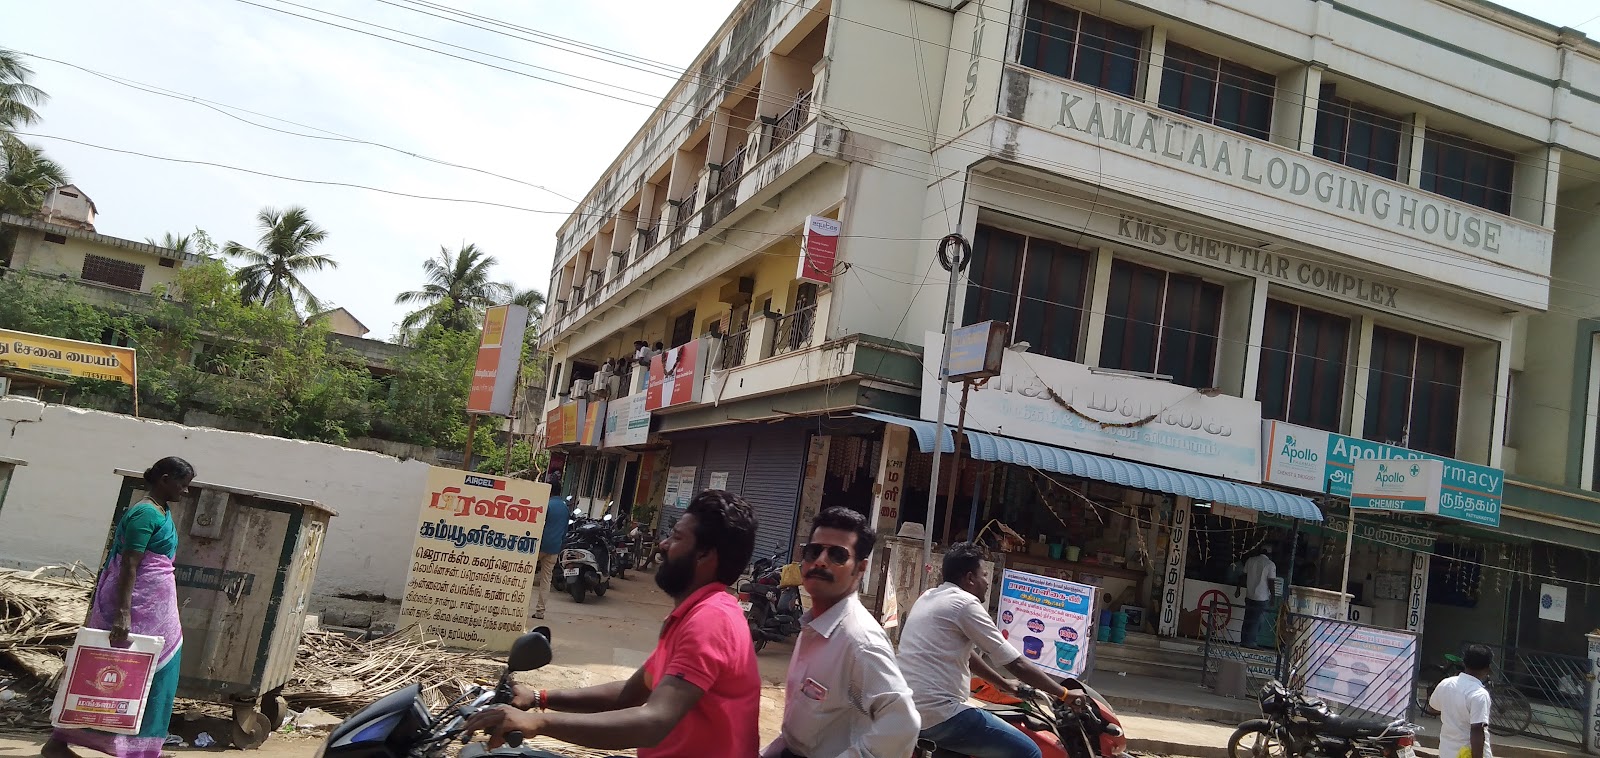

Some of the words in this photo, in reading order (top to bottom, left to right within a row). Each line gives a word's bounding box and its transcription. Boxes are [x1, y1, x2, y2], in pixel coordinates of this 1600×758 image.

[1056, 91, 1232, 176] KAMALAA
[1241, 148, 1391, 220] LODGING
[1397, 195, 1502, 254] HOUSE
[1118, 214, 1168, 246] KMS
[1174, 231, 1290, 280] CHETTIAR
[1297, 263, 1399, 309] COMPLEX
[13, 341, 62, 360] சேவை
[65, 353, 120, 368] மையம்
[1281, 444, 1318, 463] Apollo
[465, 475, 494, 487] AIRCEL
[1375, 470, 1405, 488] Apollo
[428, 487, 544, 524] பிரவின்
[1368, 498, 1406, 510] CHEMIST
[104, 672, 117, 683] M
